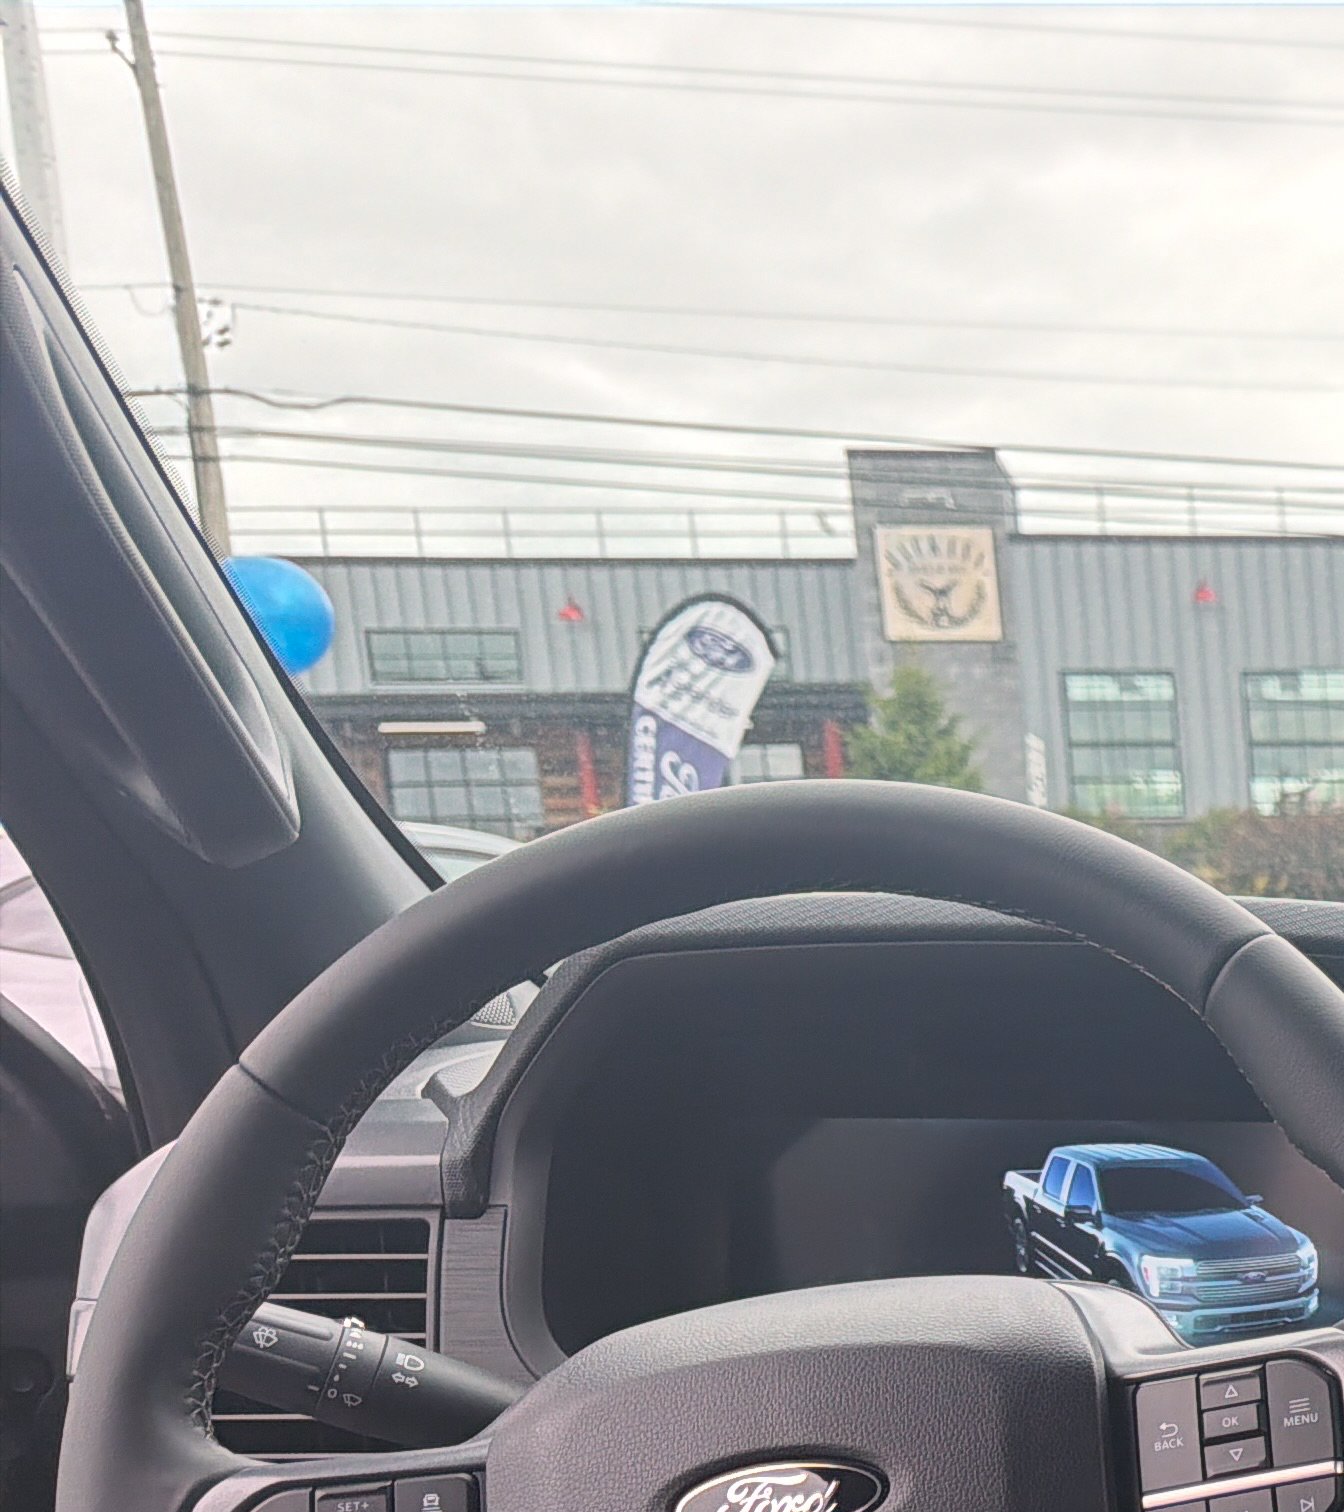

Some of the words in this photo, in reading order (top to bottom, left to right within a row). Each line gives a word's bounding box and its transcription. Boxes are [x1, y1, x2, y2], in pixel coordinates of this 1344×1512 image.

[1221, 1416, 1239, 1428] OK
[1283, 1412, 1319, 1428] MENU
[1154, 1437, 1184, 1452] BACK
[337, 1501, 370, 1512] SET+
